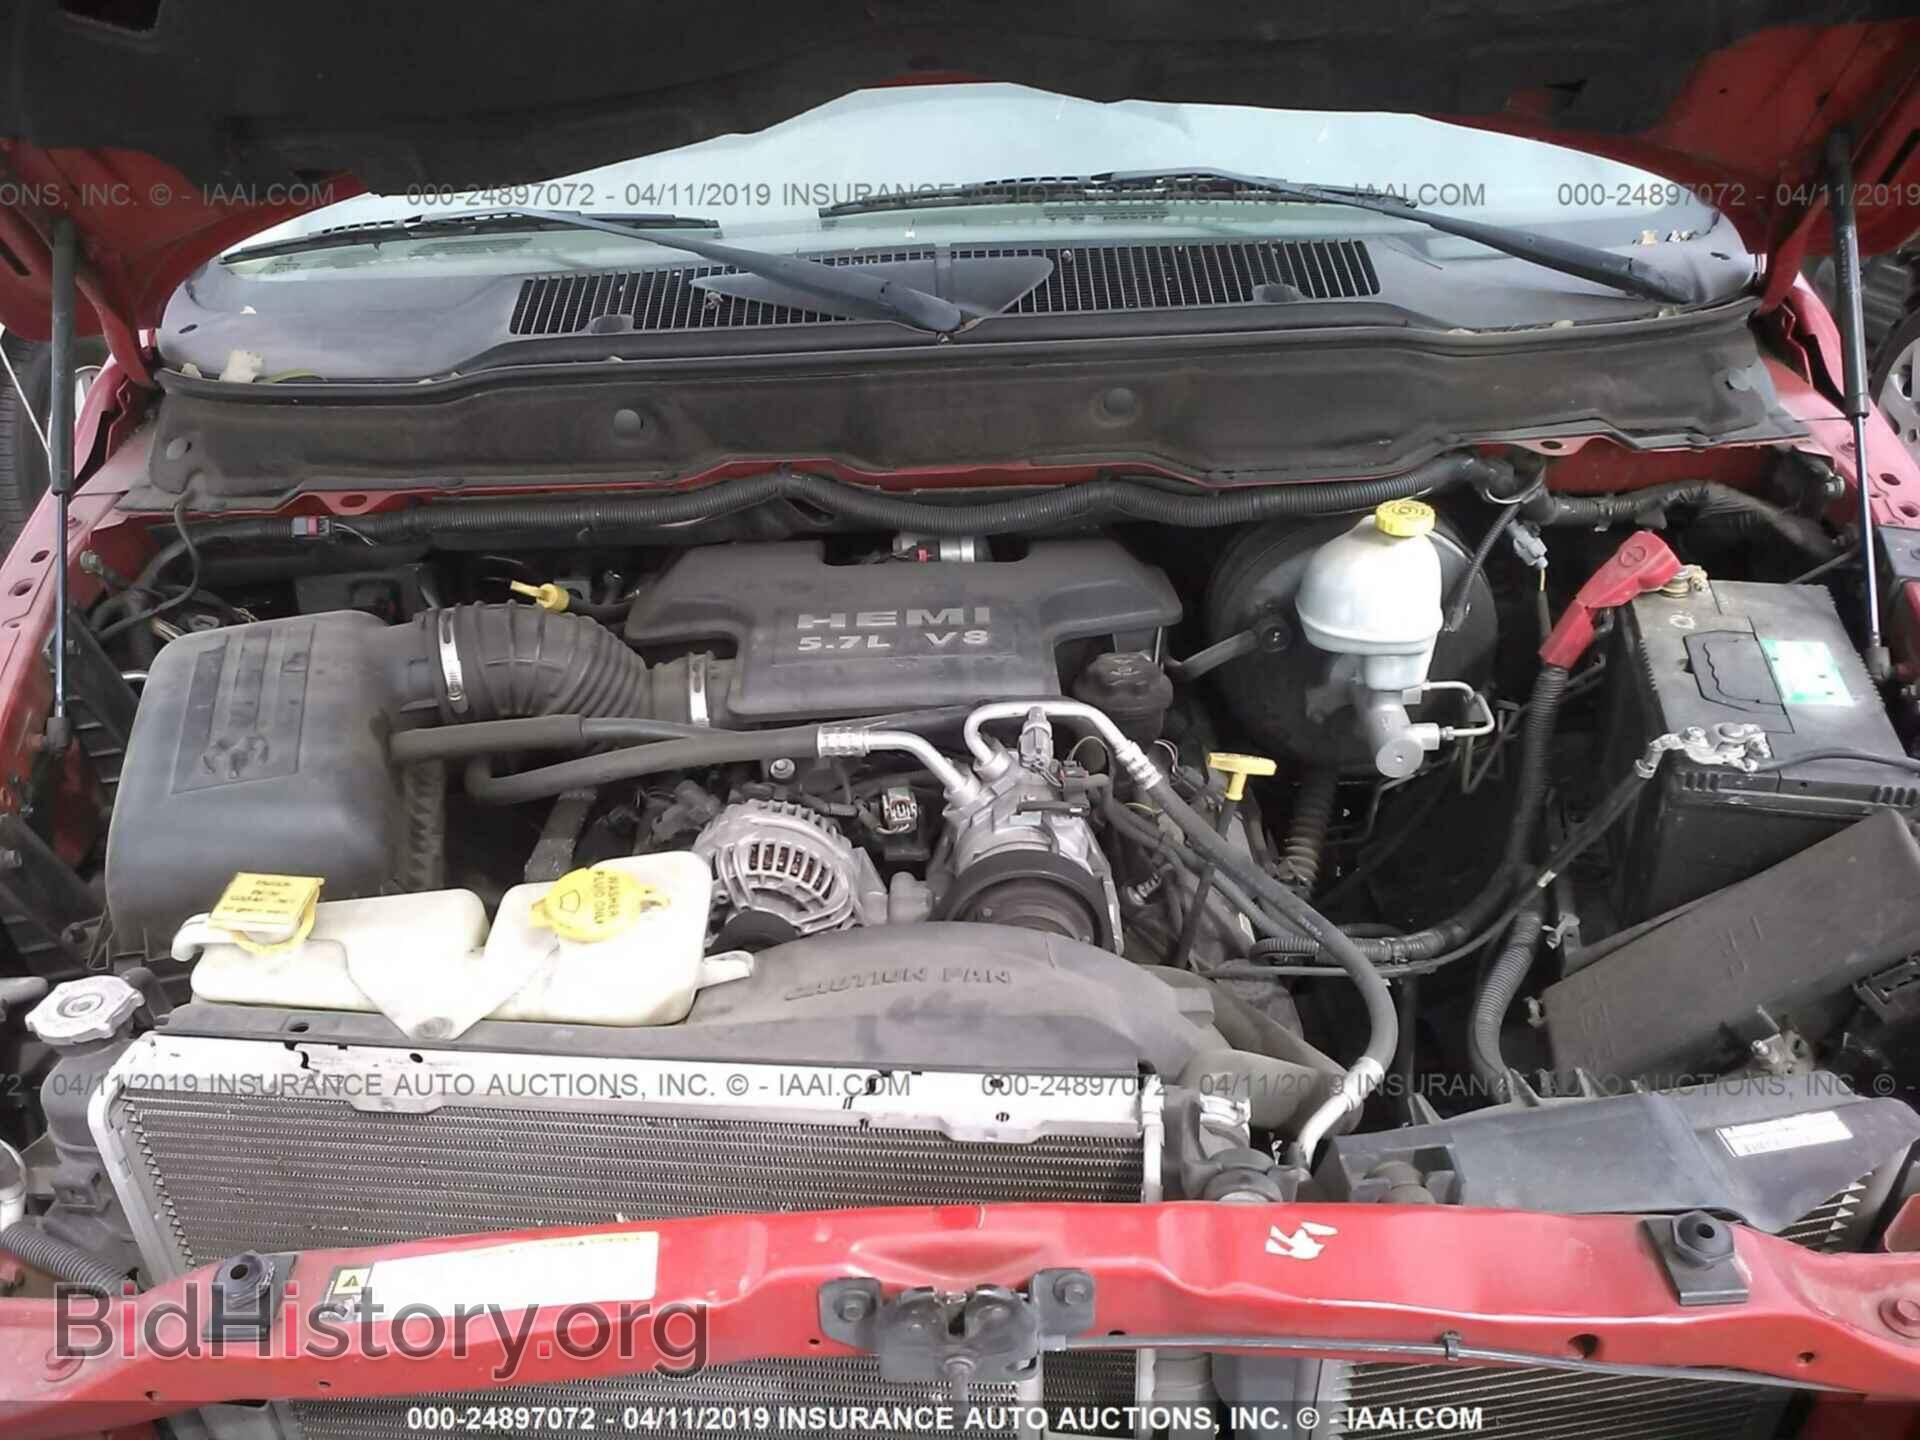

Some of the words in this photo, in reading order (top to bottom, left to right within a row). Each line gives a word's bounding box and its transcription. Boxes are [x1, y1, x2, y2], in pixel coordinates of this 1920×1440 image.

[797, 607, 991, 629] HEMI
[796, 634, 891, 651] 5.7L
[924, 630, 990, 648] V8
[939, 966, 1013, 985] FAN
